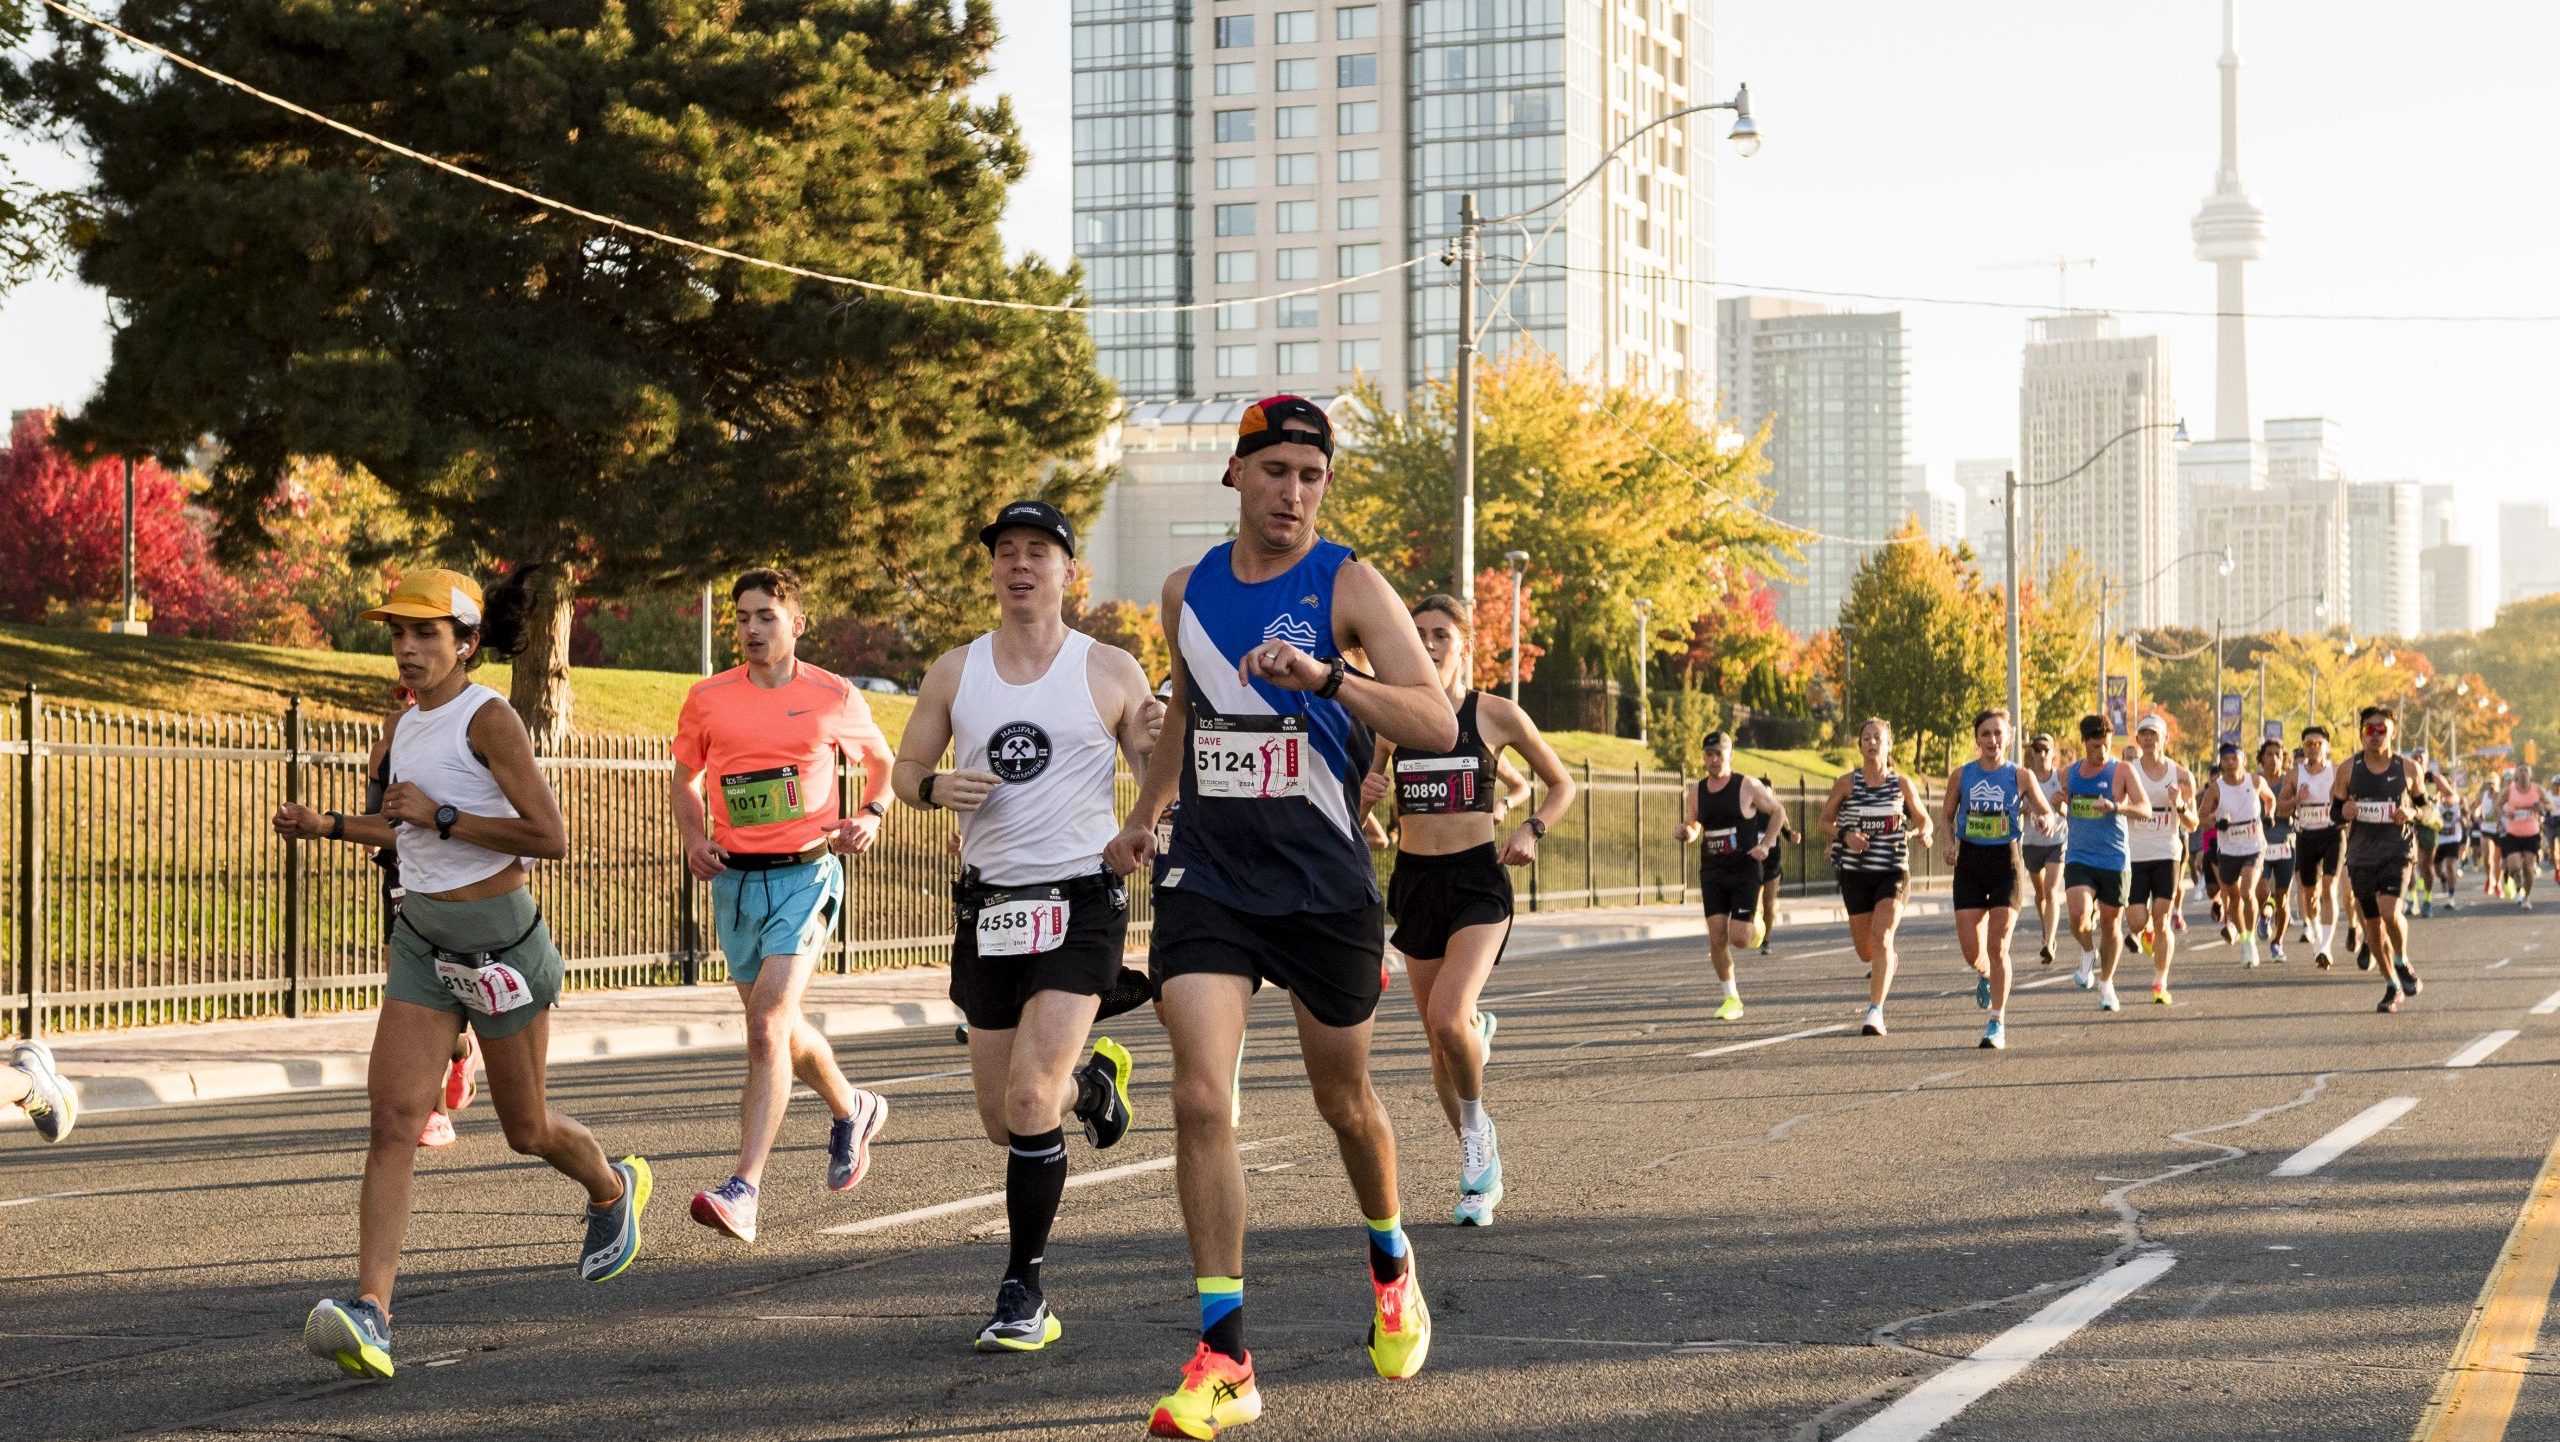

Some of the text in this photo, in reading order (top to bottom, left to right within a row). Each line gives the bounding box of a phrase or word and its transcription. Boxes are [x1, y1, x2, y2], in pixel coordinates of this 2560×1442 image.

[1200, 718, 1214, 729] tcs
[1000, 726, 1037, 738] HALIFAX
[1198, 737, 1221, 746] DAVE
[1198, 751, 1256, 772] 5124
[993, 760, 1045, 780] ROAD HAMMERS
[1403, 783, 1447, 798] 20890
[730, 794, 767, 812] 1017
[1862, 820, 1885, 829] 22305
[979, 912, 1027, 932] 4558
[442, 976, 481, 996] 8151
